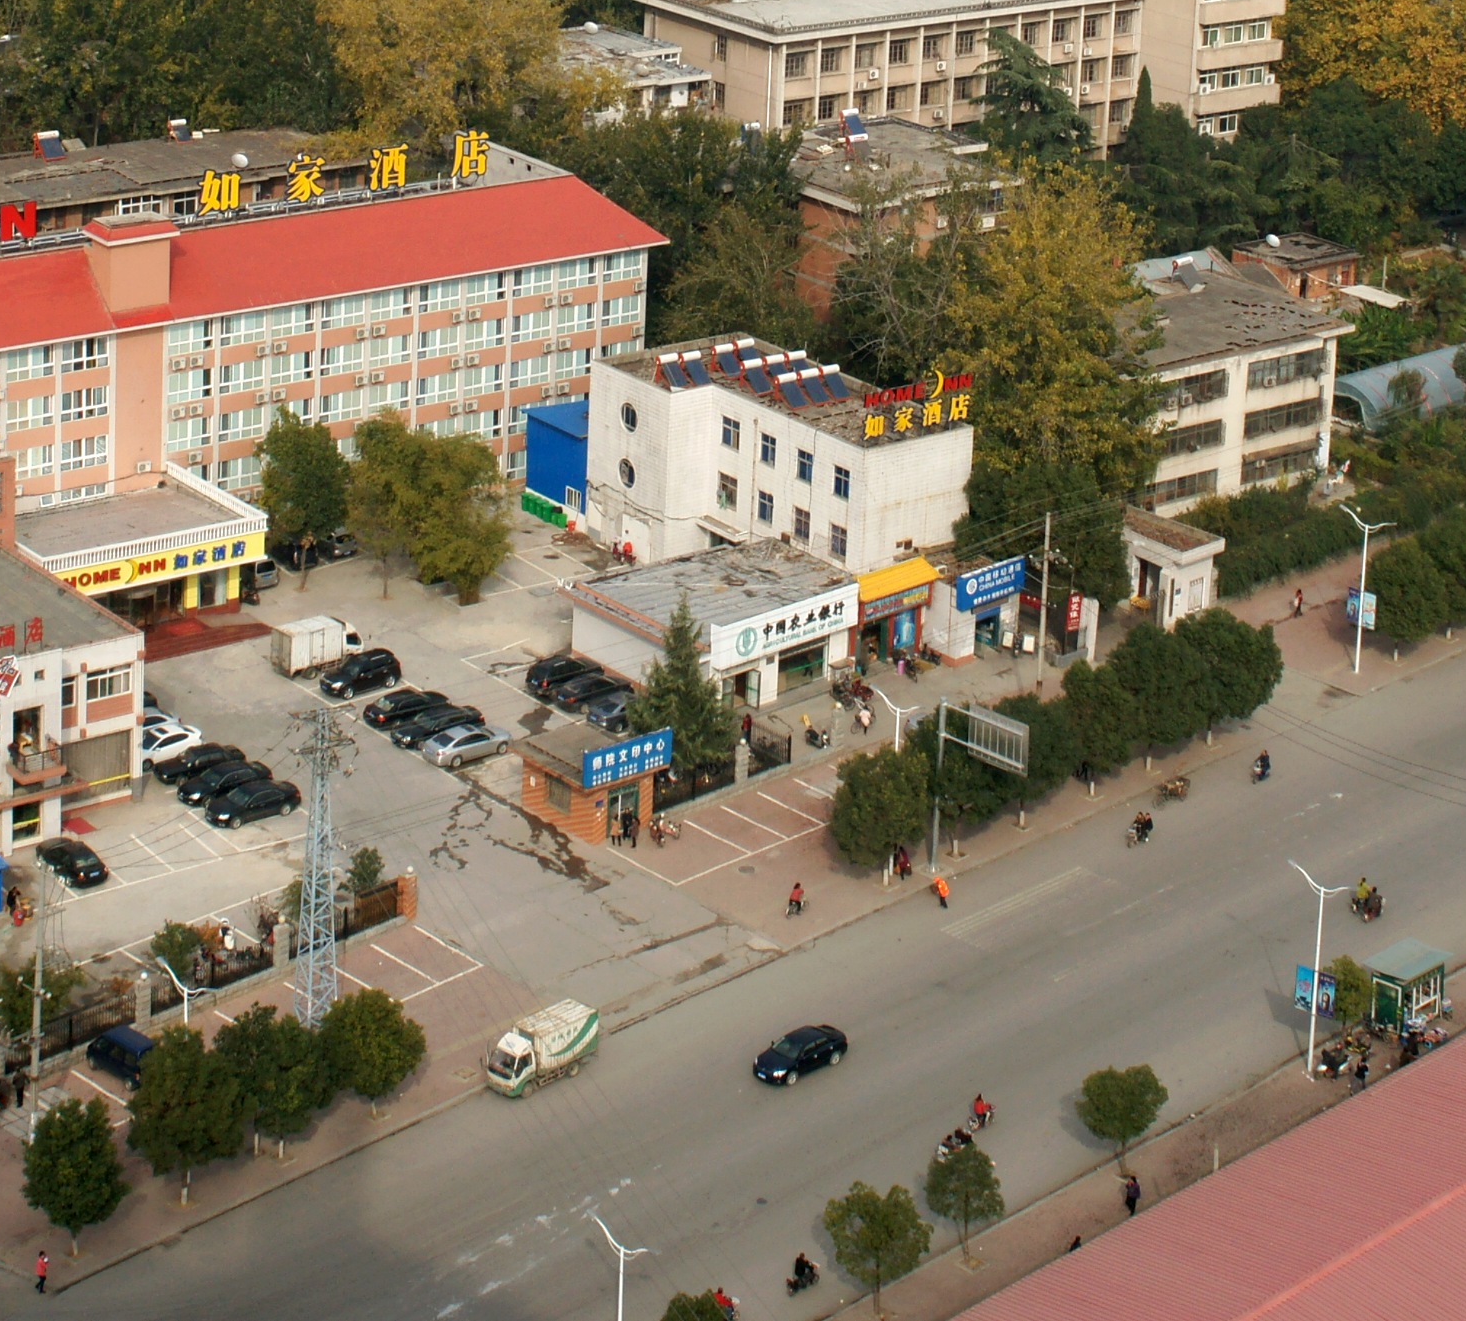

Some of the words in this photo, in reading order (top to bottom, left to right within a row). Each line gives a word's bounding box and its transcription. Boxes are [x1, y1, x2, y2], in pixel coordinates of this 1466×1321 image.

[198, 130, 490, 217] 如家酒店
[864, 382, 927, 408] HOME
[863, 393, 971, 441] 如家酒店
[173, 540, 246, 570] 如家酒店
[64, 567, 121, 589] HOME
[977, 561, 1022, 584] 中国移动通信
[978, 580, 995, 592] CHINA
[995, 573, 1016, 586] MOBILE
[762, 600, 846, 641] 中国农业银行
[592, 737, 665, 771] 师院文印中心
